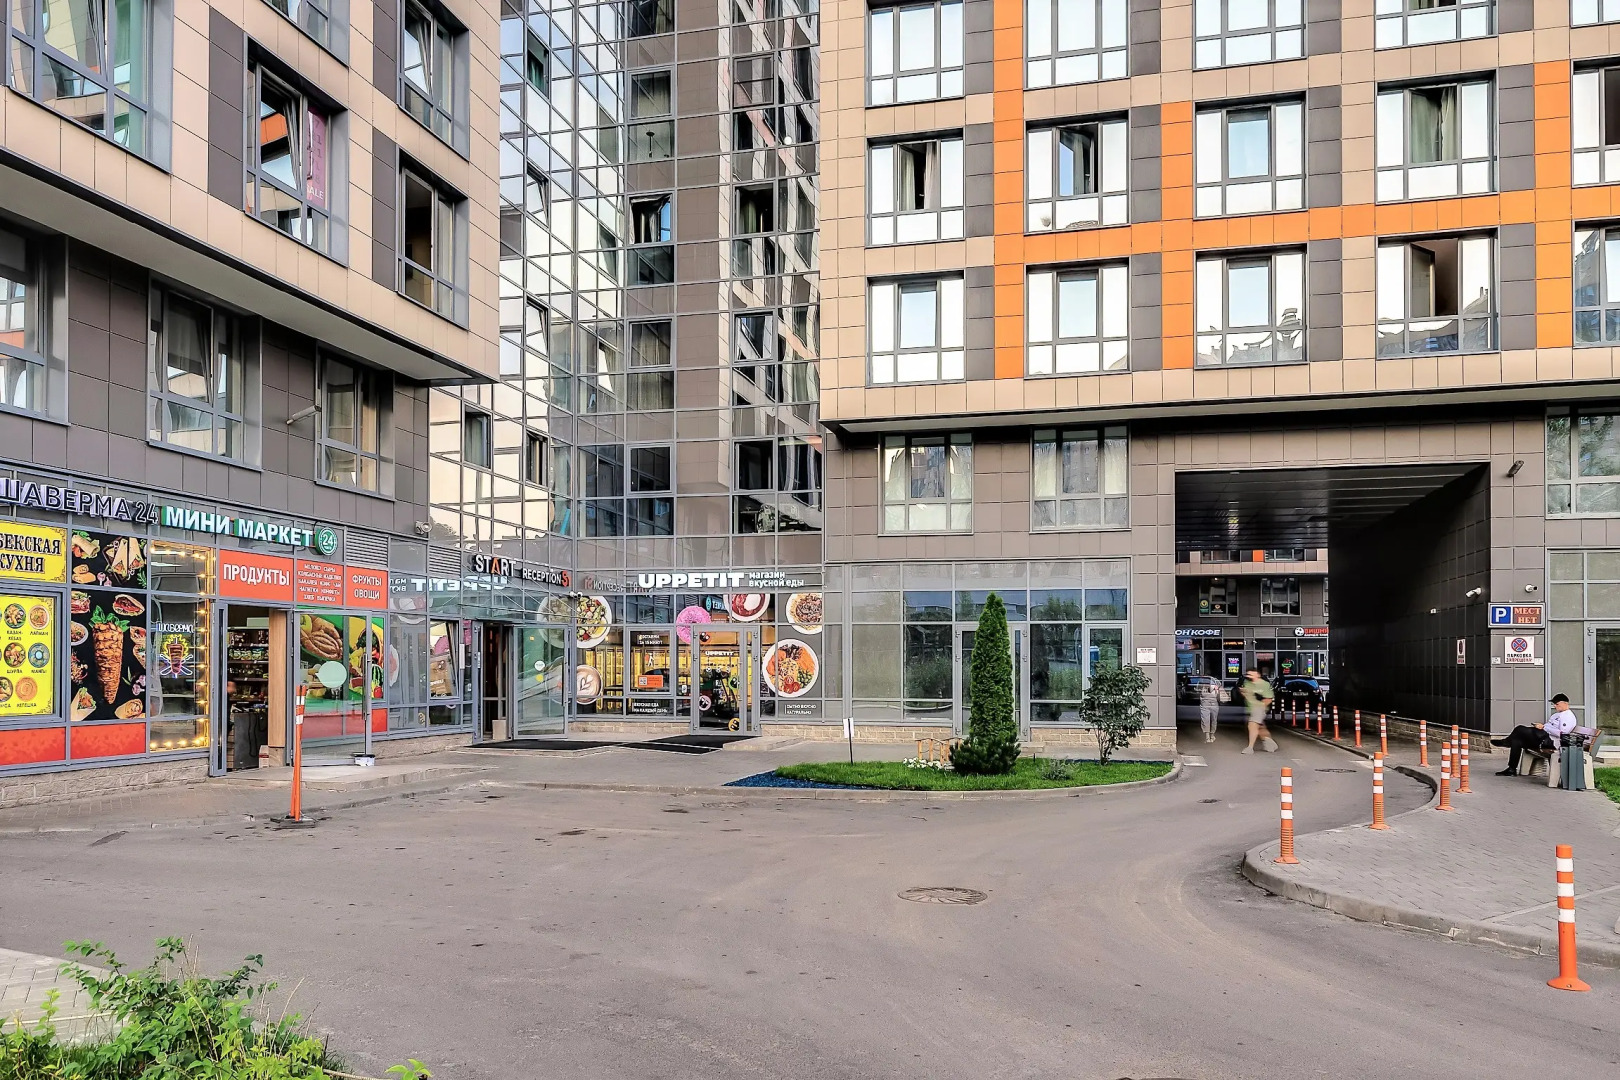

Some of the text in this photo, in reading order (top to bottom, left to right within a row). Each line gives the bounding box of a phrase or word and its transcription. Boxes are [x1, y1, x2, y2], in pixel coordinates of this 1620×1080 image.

[0, 477, 159, 524] ШАВЕРМА 24
[165, 505, 314, 547] МИНИ МАРКЕТ
[321, 534, 334, 546] 24
[475, 554, 517, 577] START
[223, 563, 290, 586] ПРОДУКТЫ
[352, 574, 382, 587] ФРУКТЫ
[522, 568, 562, 585] RECEPTION
[638, 572, 745, 589] UPPETIT
[749, 578, 805, 589] вкусной еды
[354, 588, 380, 600] ОВОЩИ
[1514, 607, 1540, 615] МЕСТ
[1517, 616, 1538, 624] НЕТ
